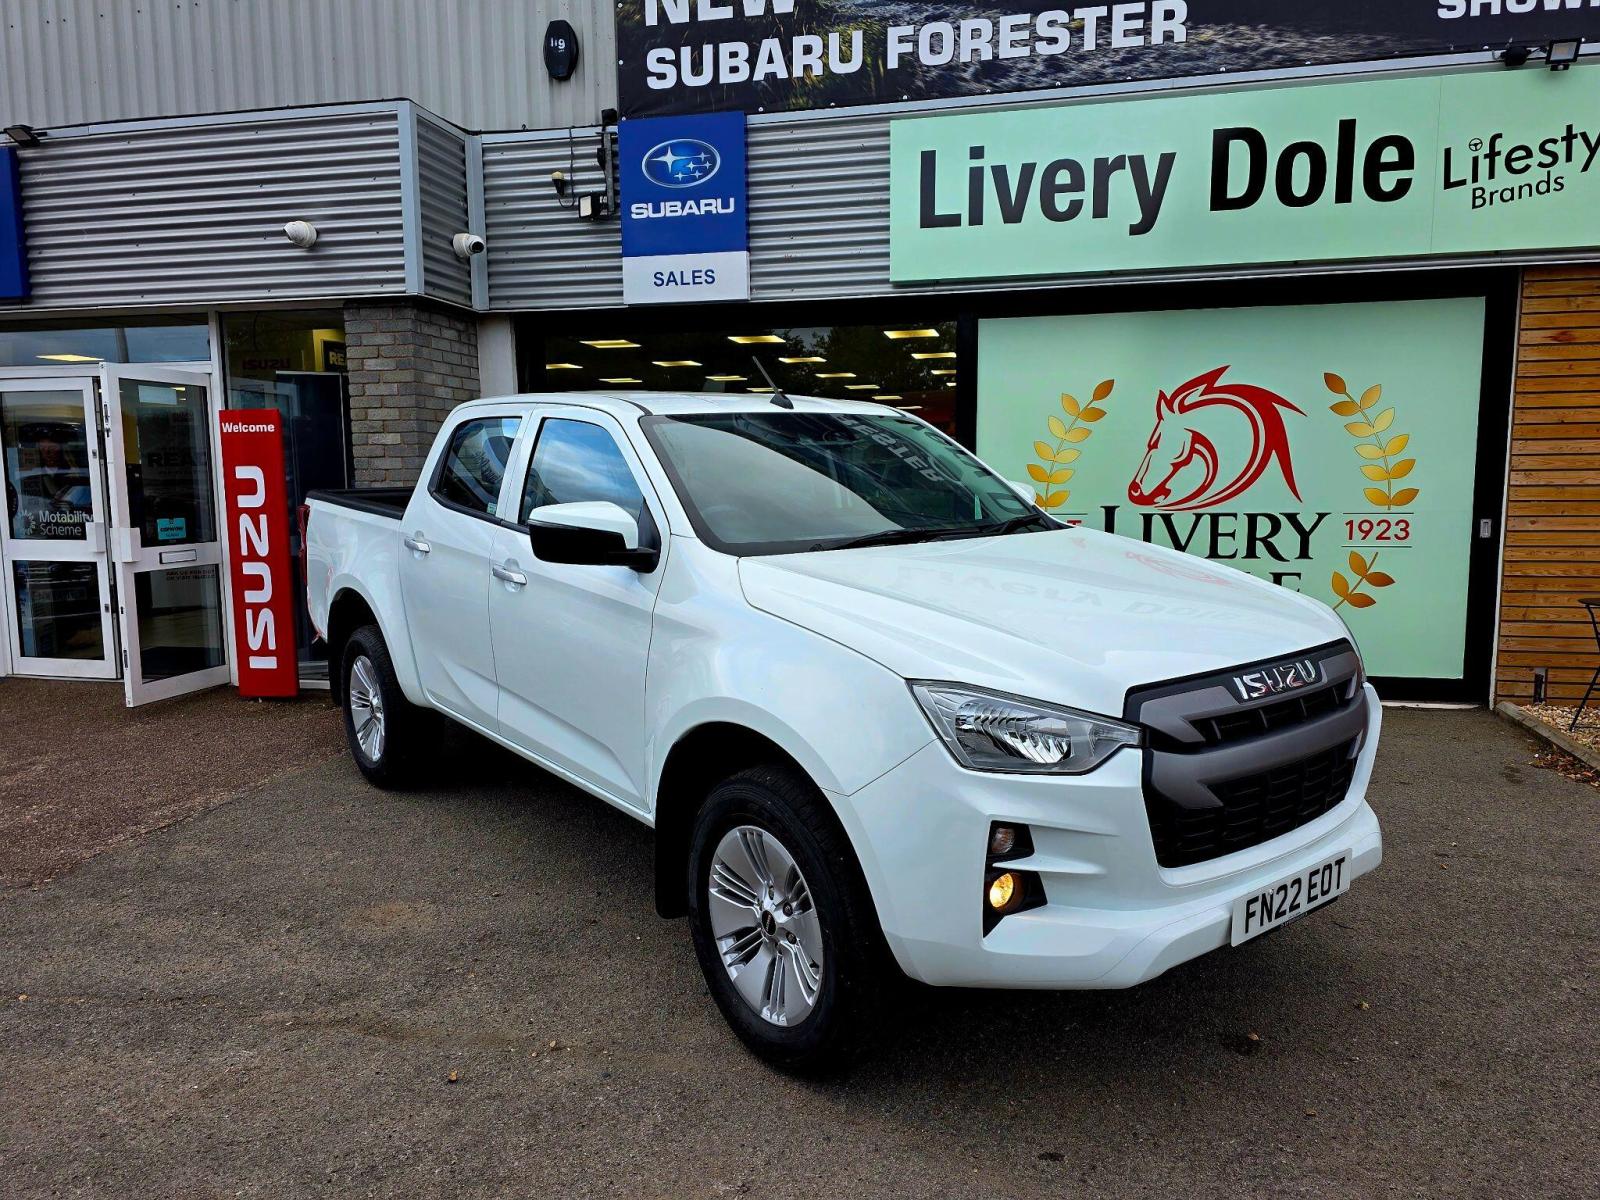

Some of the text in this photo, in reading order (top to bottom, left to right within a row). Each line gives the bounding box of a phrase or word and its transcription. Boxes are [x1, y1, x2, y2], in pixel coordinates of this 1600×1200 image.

[646, 0, 1189, 90] SUBARU FORESTER
[919, 118, 1415, 237] Livery Dole
[1471, 170, 1565, 210] Brands
[630, 198, 735, 219] SUBARU
[653, 269, 716, 287] SALES
[221, 422, 275, 433] Welcome
[39, 510, 94, 523] Motability
[40, 523, 82, 537] Scheme
[1344, 518, 1411, 541] 1923
[235, 465, 278, 669] ISUZU
[1233, 659, 1316, 700] ISUZU
[1244, 877, 1302, 934] FN22
